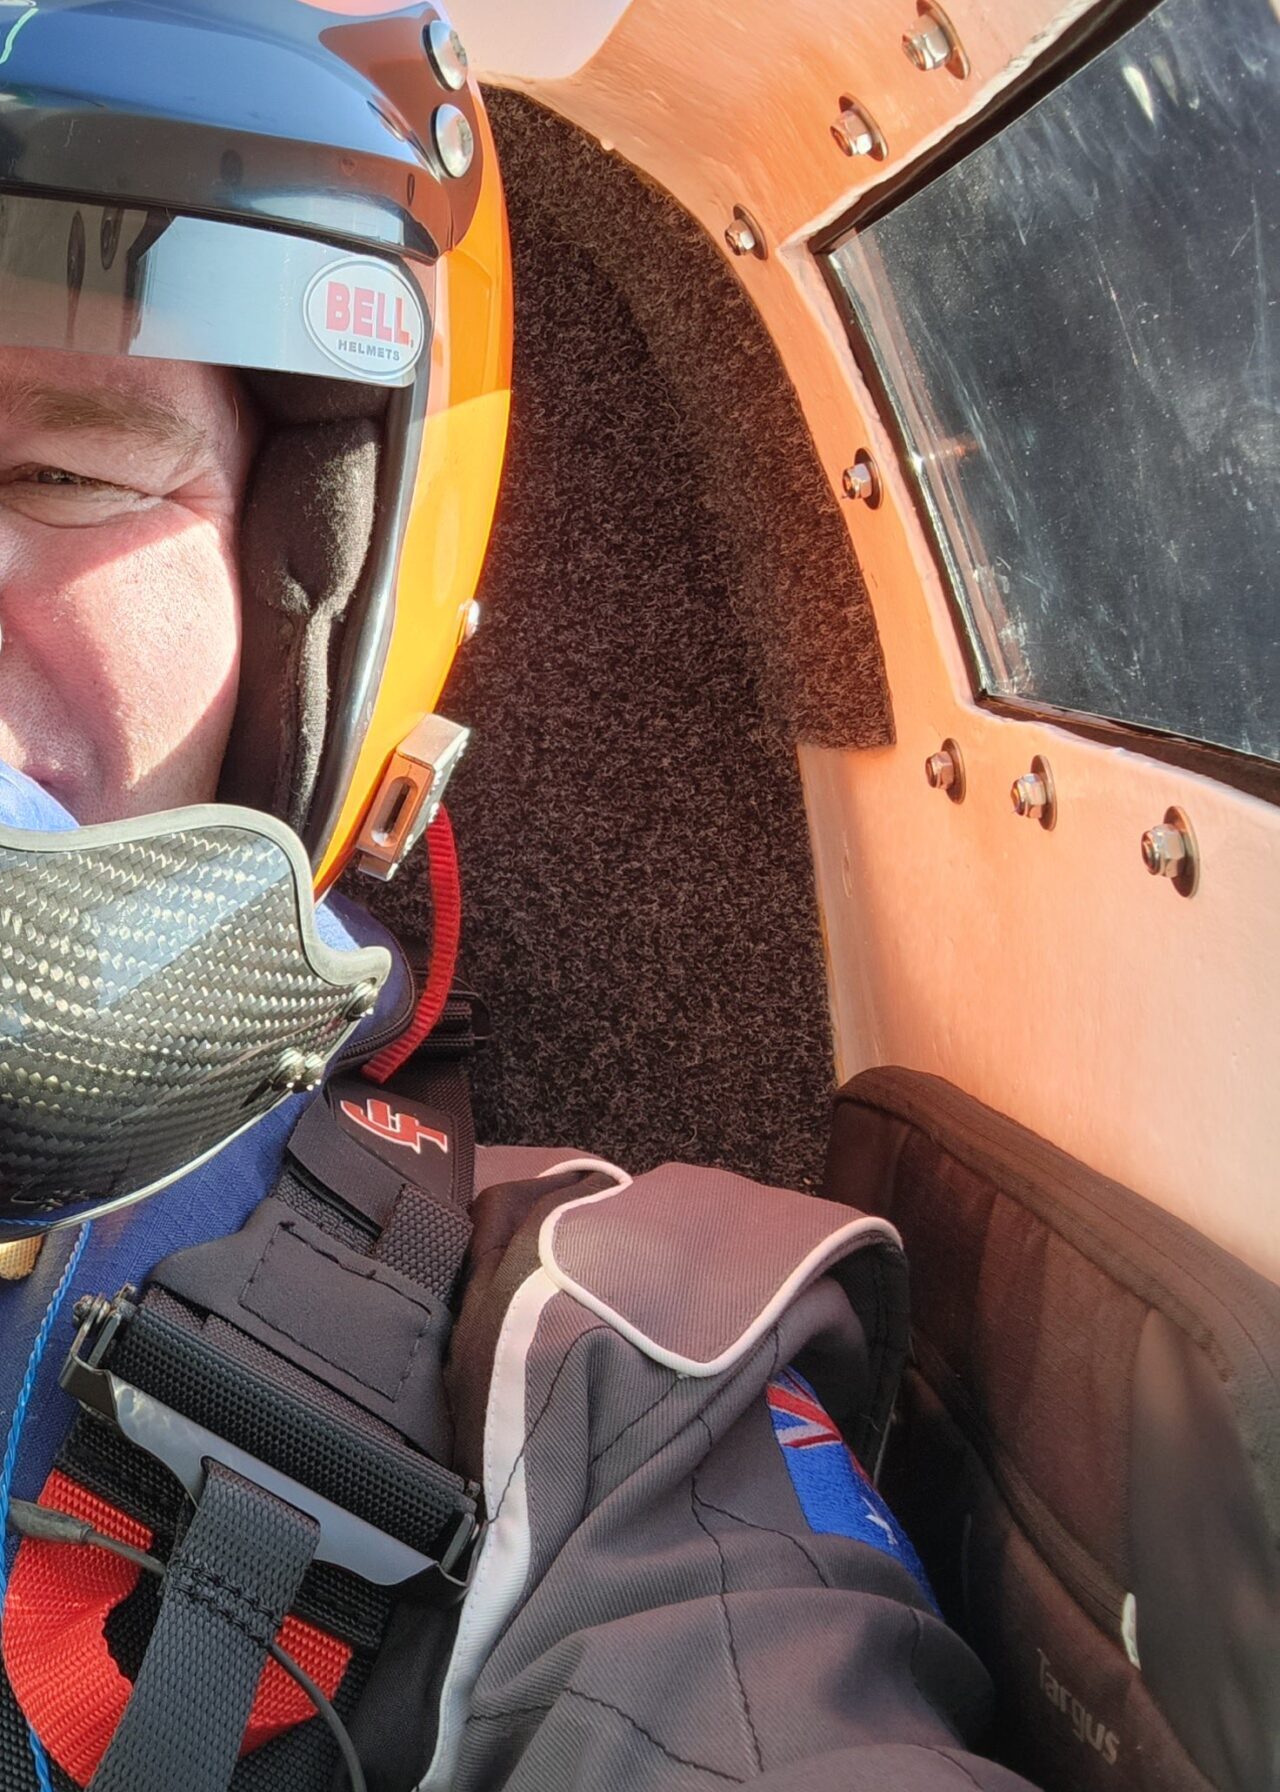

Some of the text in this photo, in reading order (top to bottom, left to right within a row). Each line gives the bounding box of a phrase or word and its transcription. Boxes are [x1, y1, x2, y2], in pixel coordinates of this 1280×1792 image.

[325, 281, 410, 346] BELL
[337, 339, 401, 361] HELMETS
[1037, 1647, 1120, 1766] Targus
